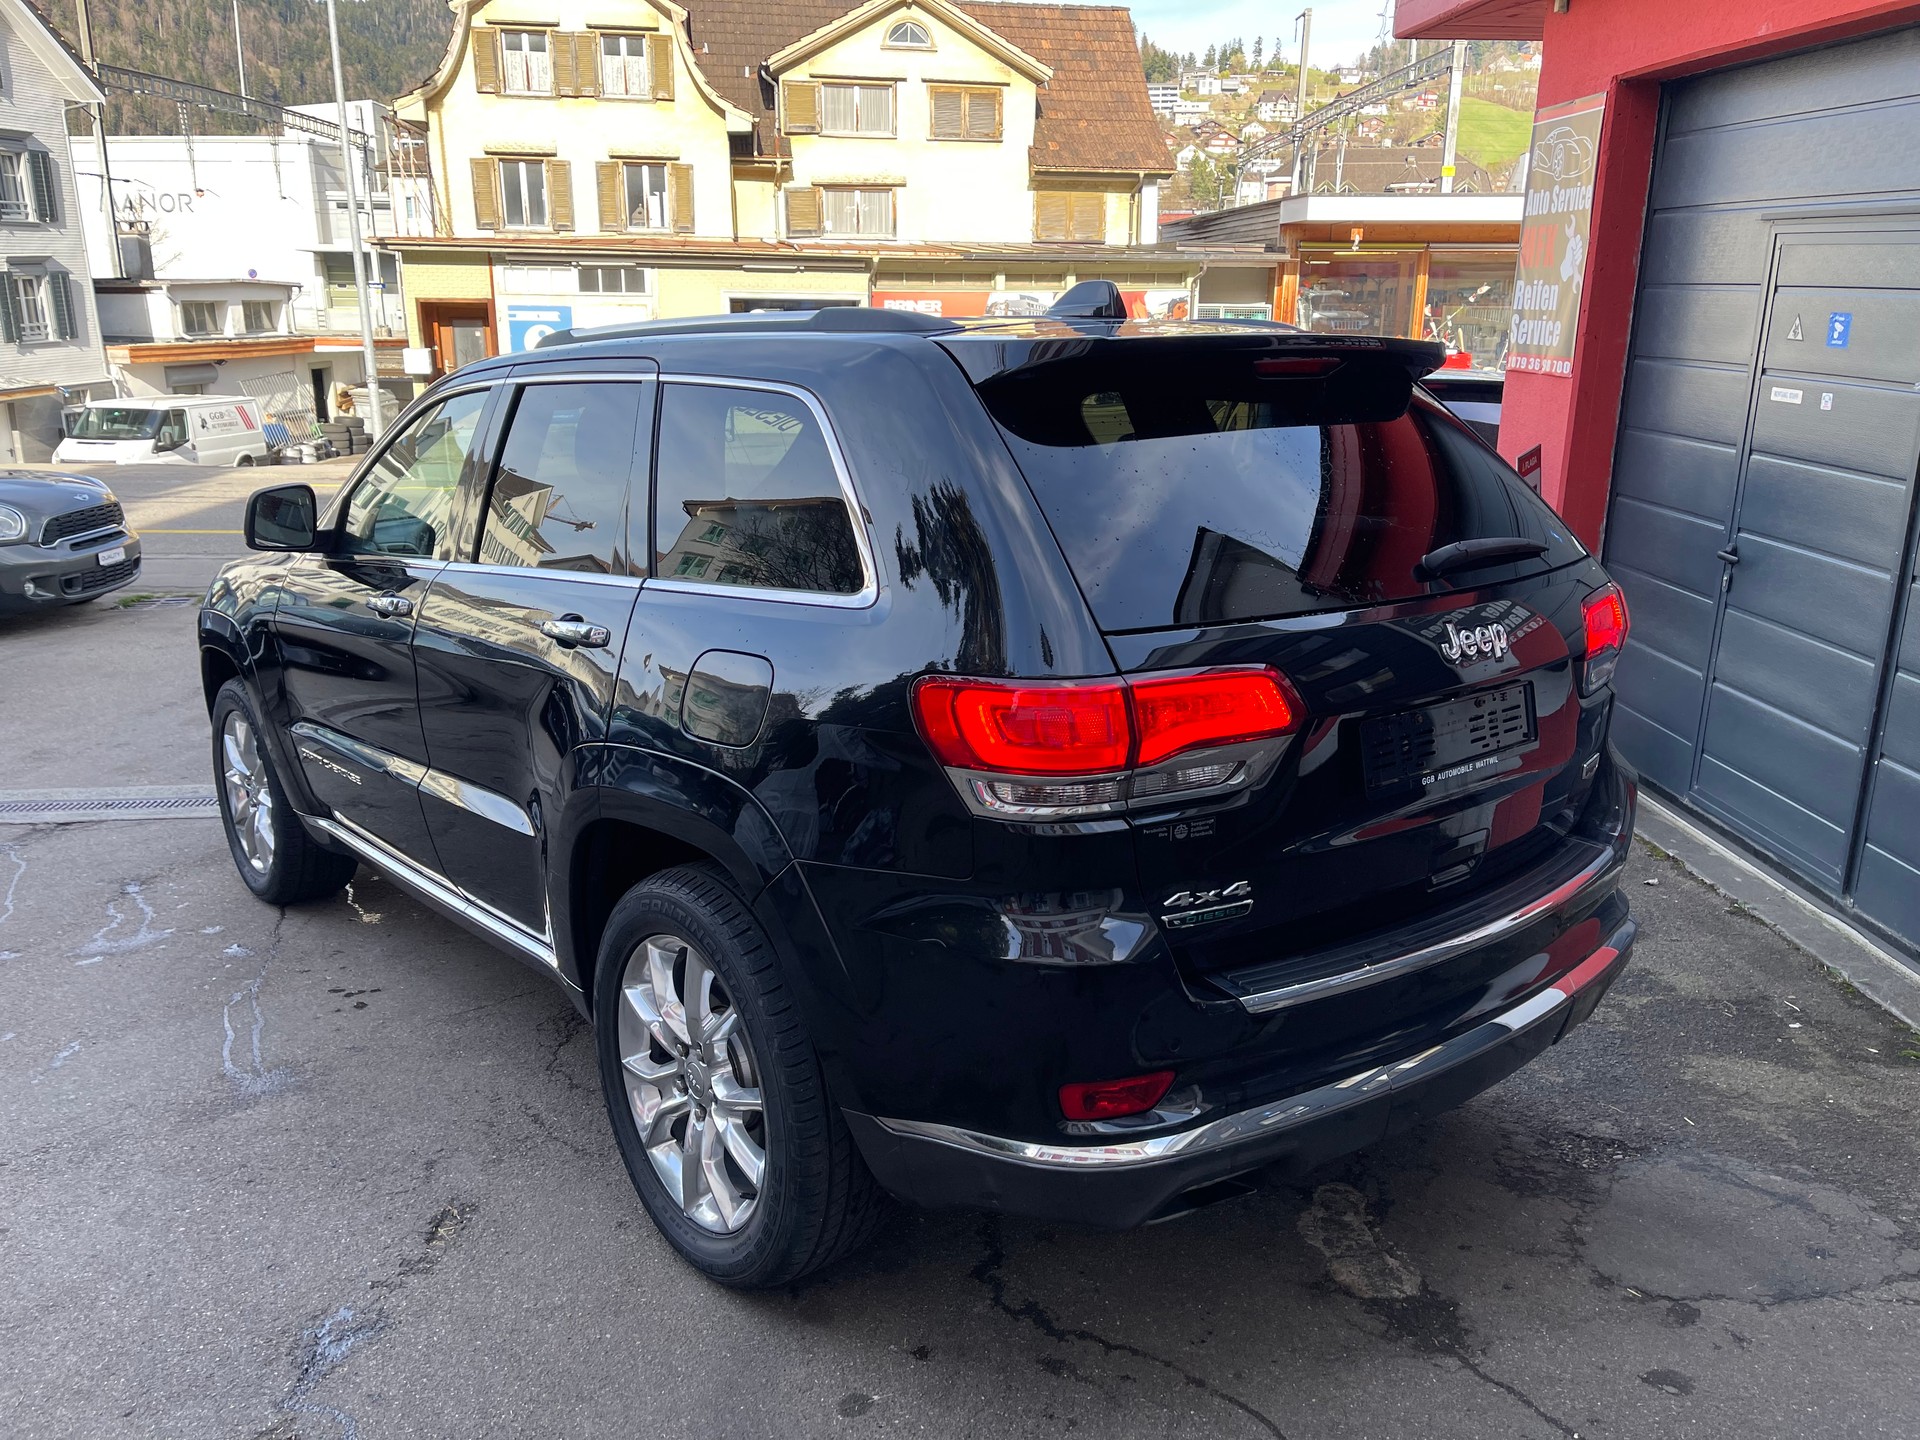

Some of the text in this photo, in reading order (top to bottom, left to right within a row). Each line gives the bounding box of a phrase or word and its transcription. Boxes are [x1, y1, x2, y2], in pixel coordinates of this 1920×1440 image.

[1525, 182, 1592, 216] Auto Service
[1513, 280, 1559, 310] Reifen
[1510, 314, 1561, 347] Service
[209, 411, 225, 420] GGB
[101, 552, 121, 561] QUALITY
[1441, 622, 1508, 659] Jeep
[1422, 755, 1499, 785] GGB AUTOMOBILE WATTWIL
[1163, 881, 1251, 906] 4x4
[639, 898, 754, 1036] CONTINENTAL
